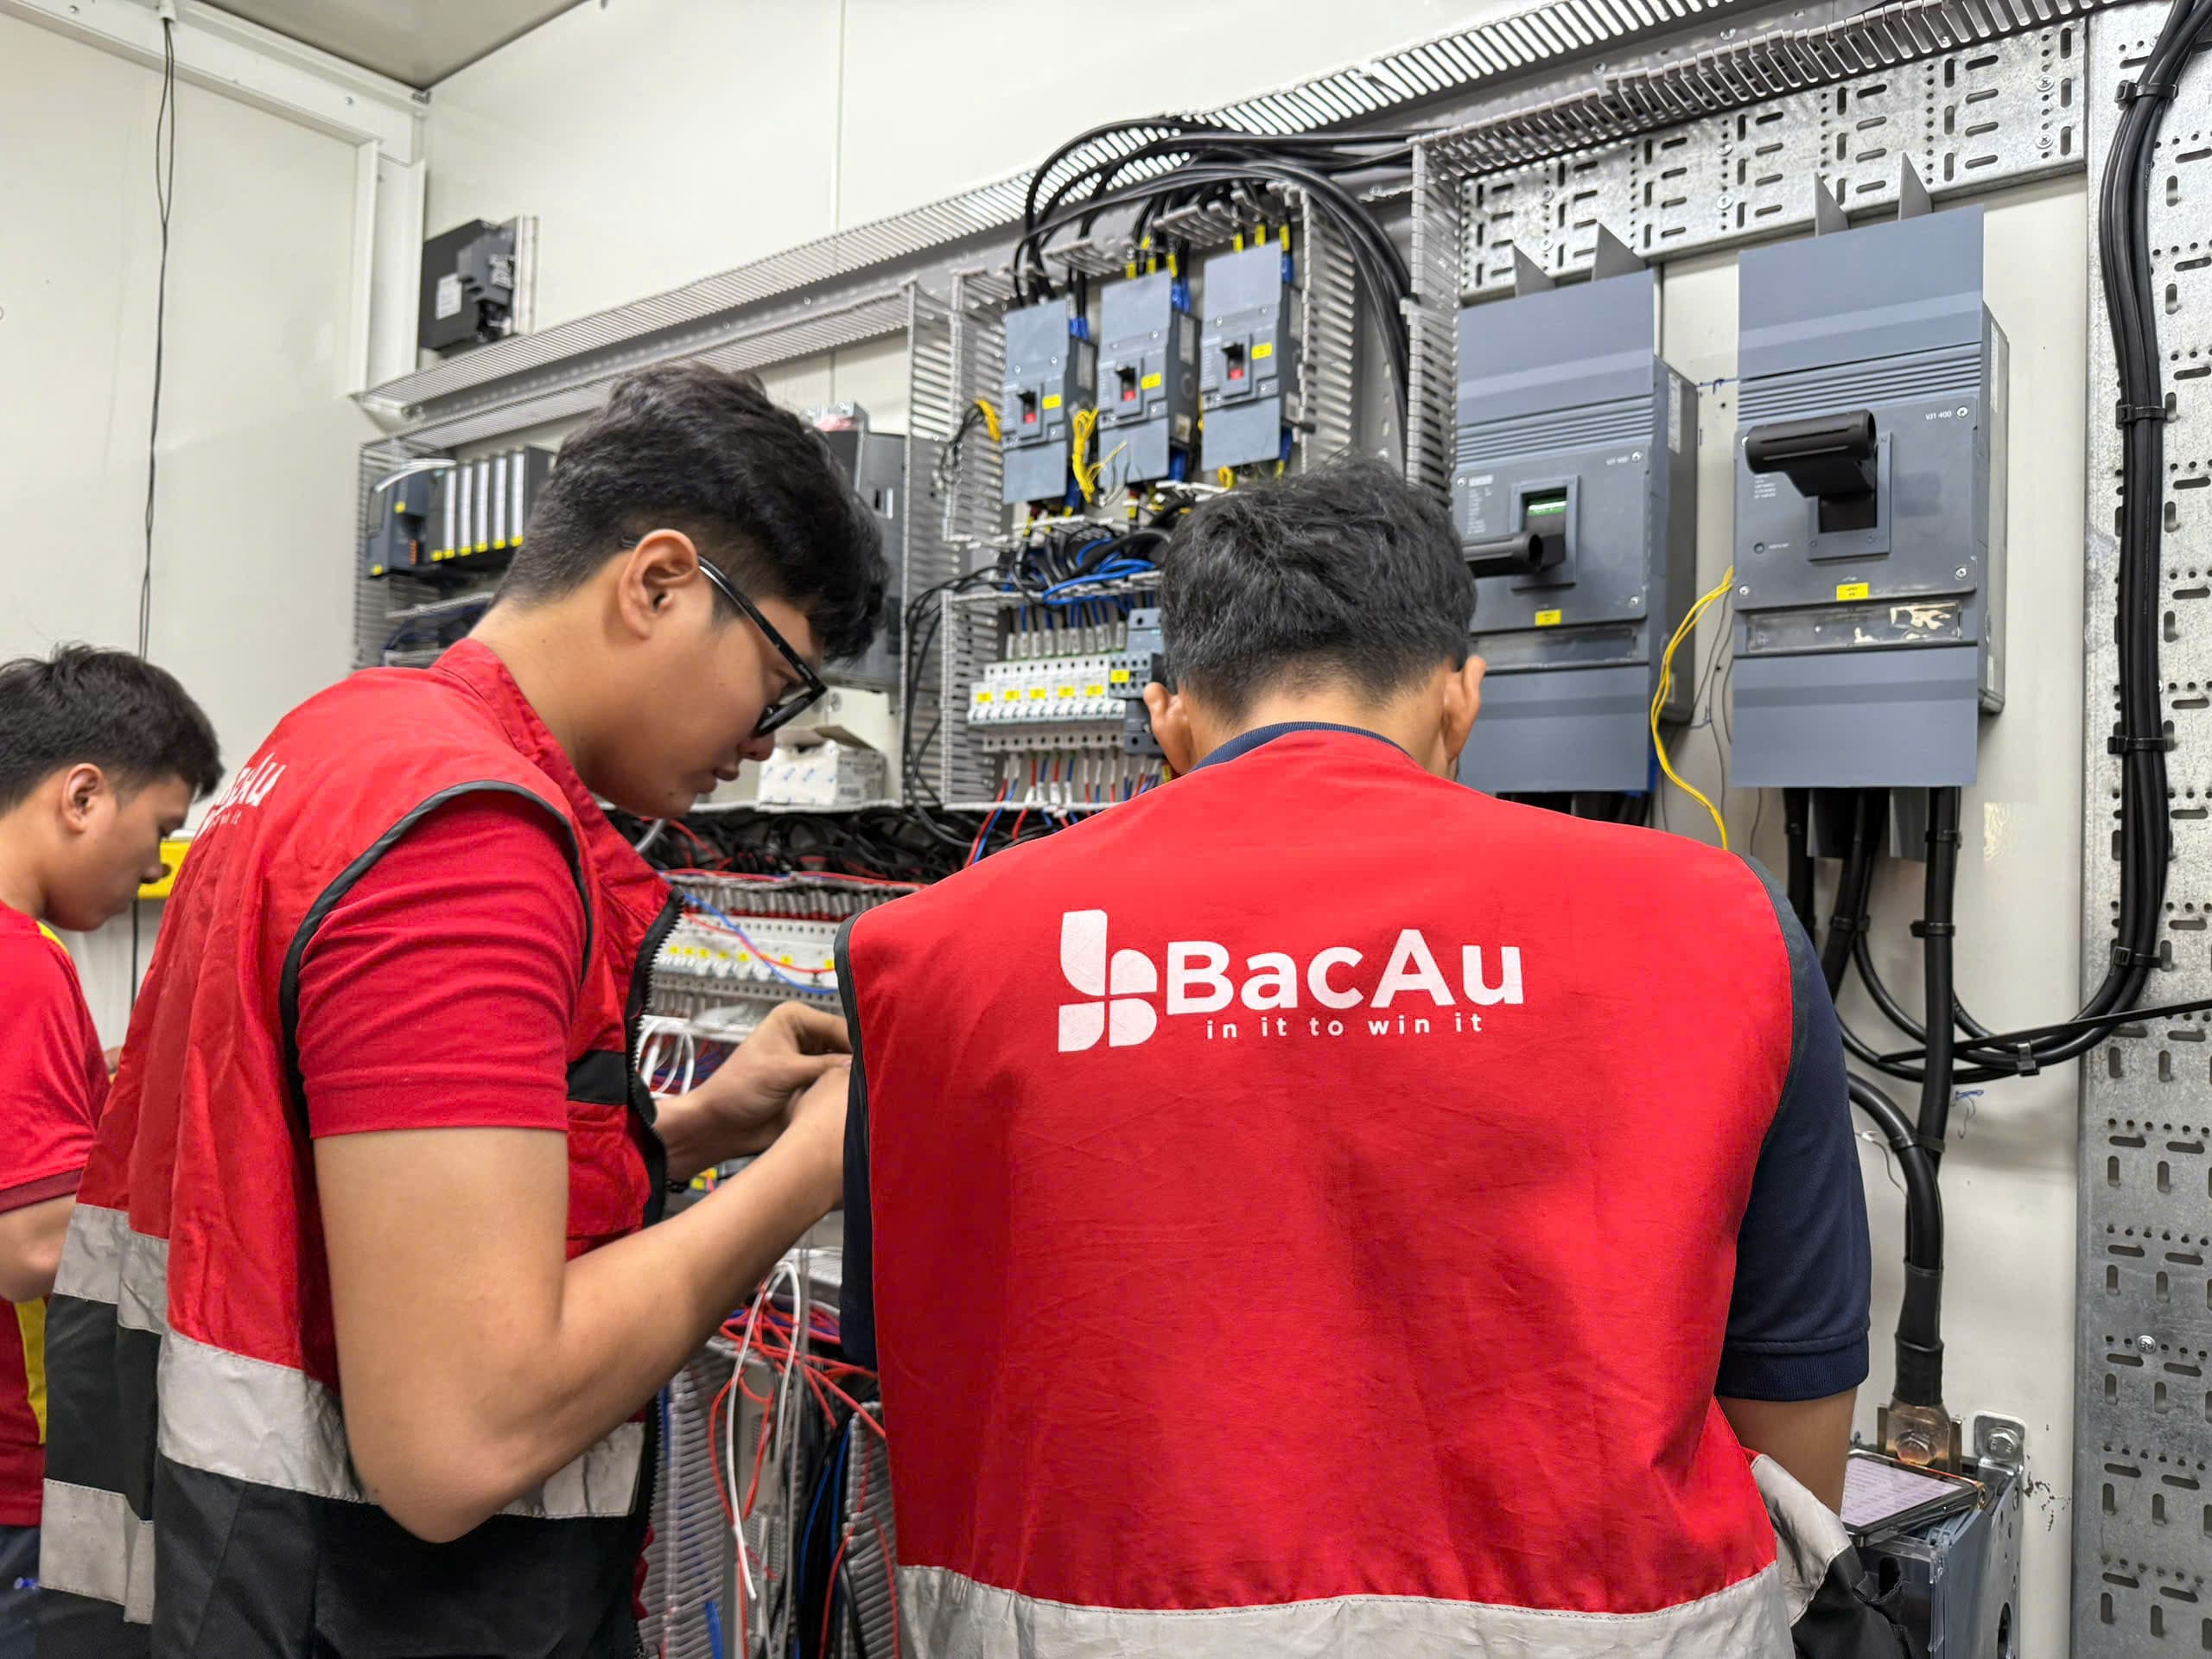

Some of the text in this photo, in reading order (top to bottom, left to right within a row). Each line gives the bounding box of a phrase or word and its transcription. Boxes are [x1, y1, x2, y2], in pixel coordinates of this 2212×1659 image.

[1166, 929, 1524, 1014] BacAu
[1207, 1013, 1482, 1039] in it to win it
